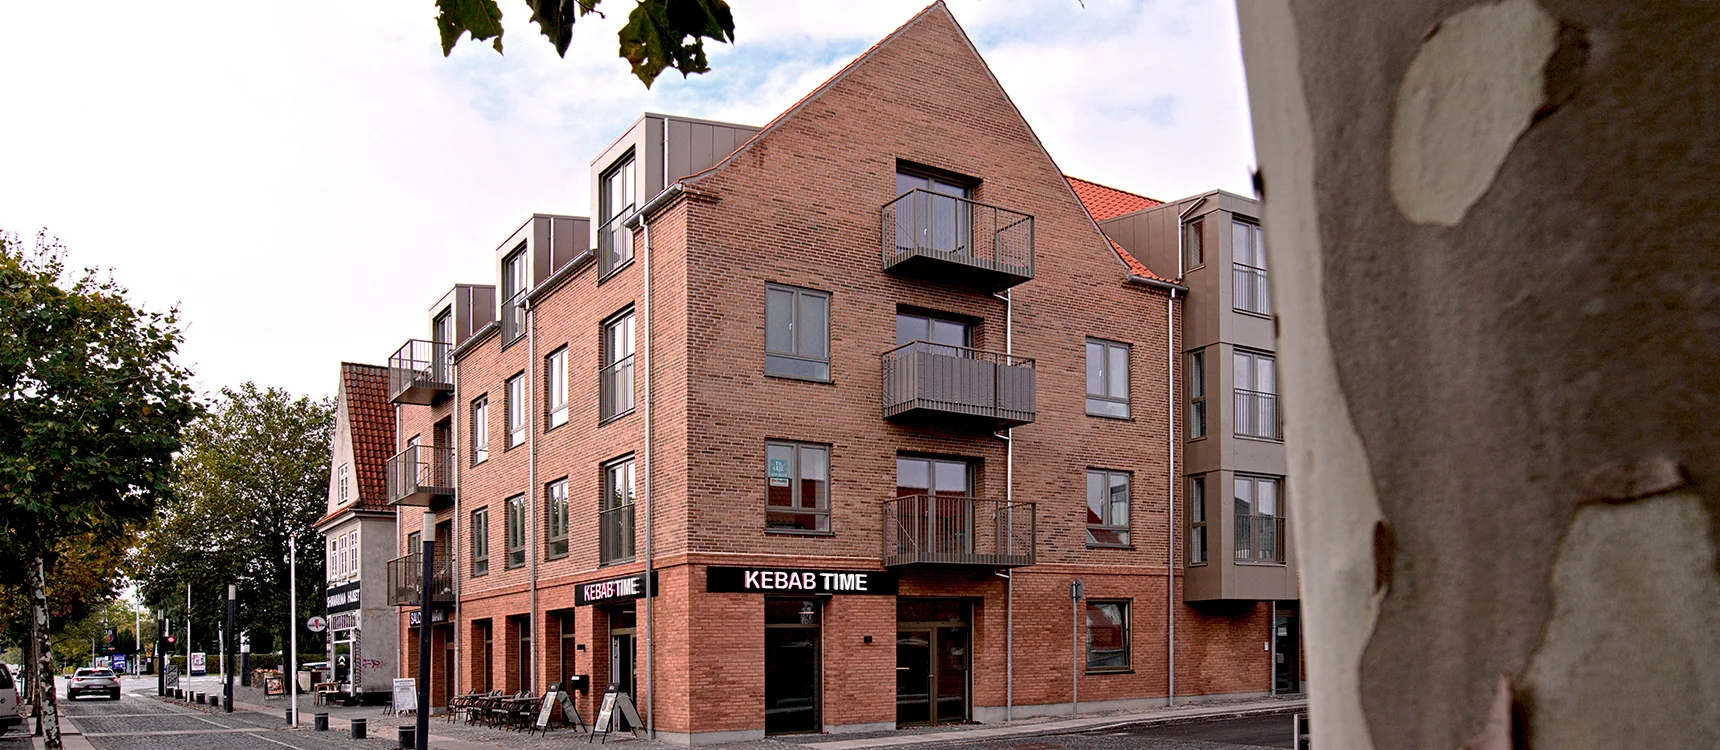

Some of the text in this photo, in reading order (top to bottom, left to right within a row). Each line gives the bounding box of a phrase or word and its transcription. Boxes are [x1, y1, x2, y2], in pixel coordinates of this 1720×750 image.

[584, 577, 640, 601] KEBAB TIME
[744, 570, 867, 590] KEBAB TIME
